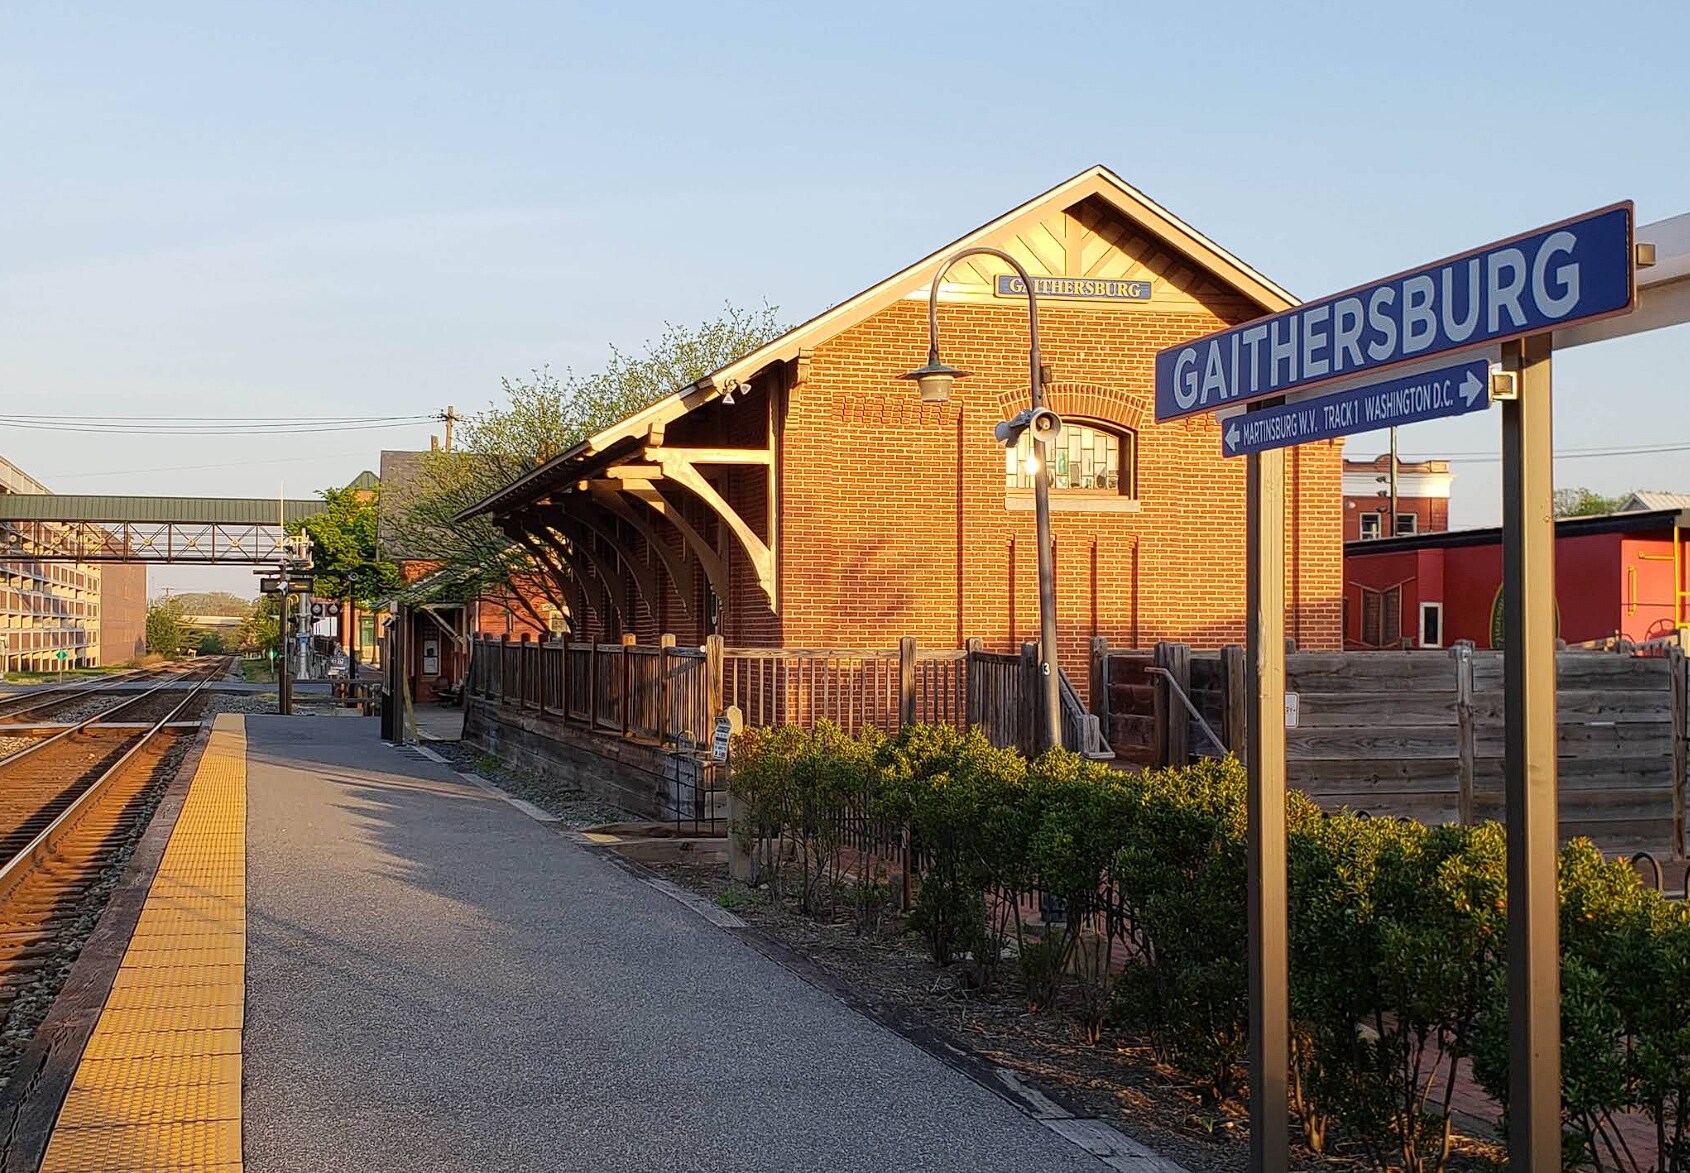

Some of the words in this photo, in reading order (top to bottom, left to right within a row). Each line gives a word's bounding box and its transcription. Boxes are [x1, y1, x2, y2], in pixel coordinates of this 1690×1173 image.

[1009, 278, 1141, 297] GITHERSBURG
[1173, 231, 1580, 409] GAITHERSBURG
[1243, 413, 1297, 446] MARTINSBURG
[1298, 409, 1318, 435] W.V.
[1323, 401, 1353, 431] TRACK
[1353, 400, 1359, 424] 1
[1365, 384, 1431, 423] WASHINGTON
[1433, 380, 1454, 410] D.C.
[1043, 662, 1050, 675] 3
